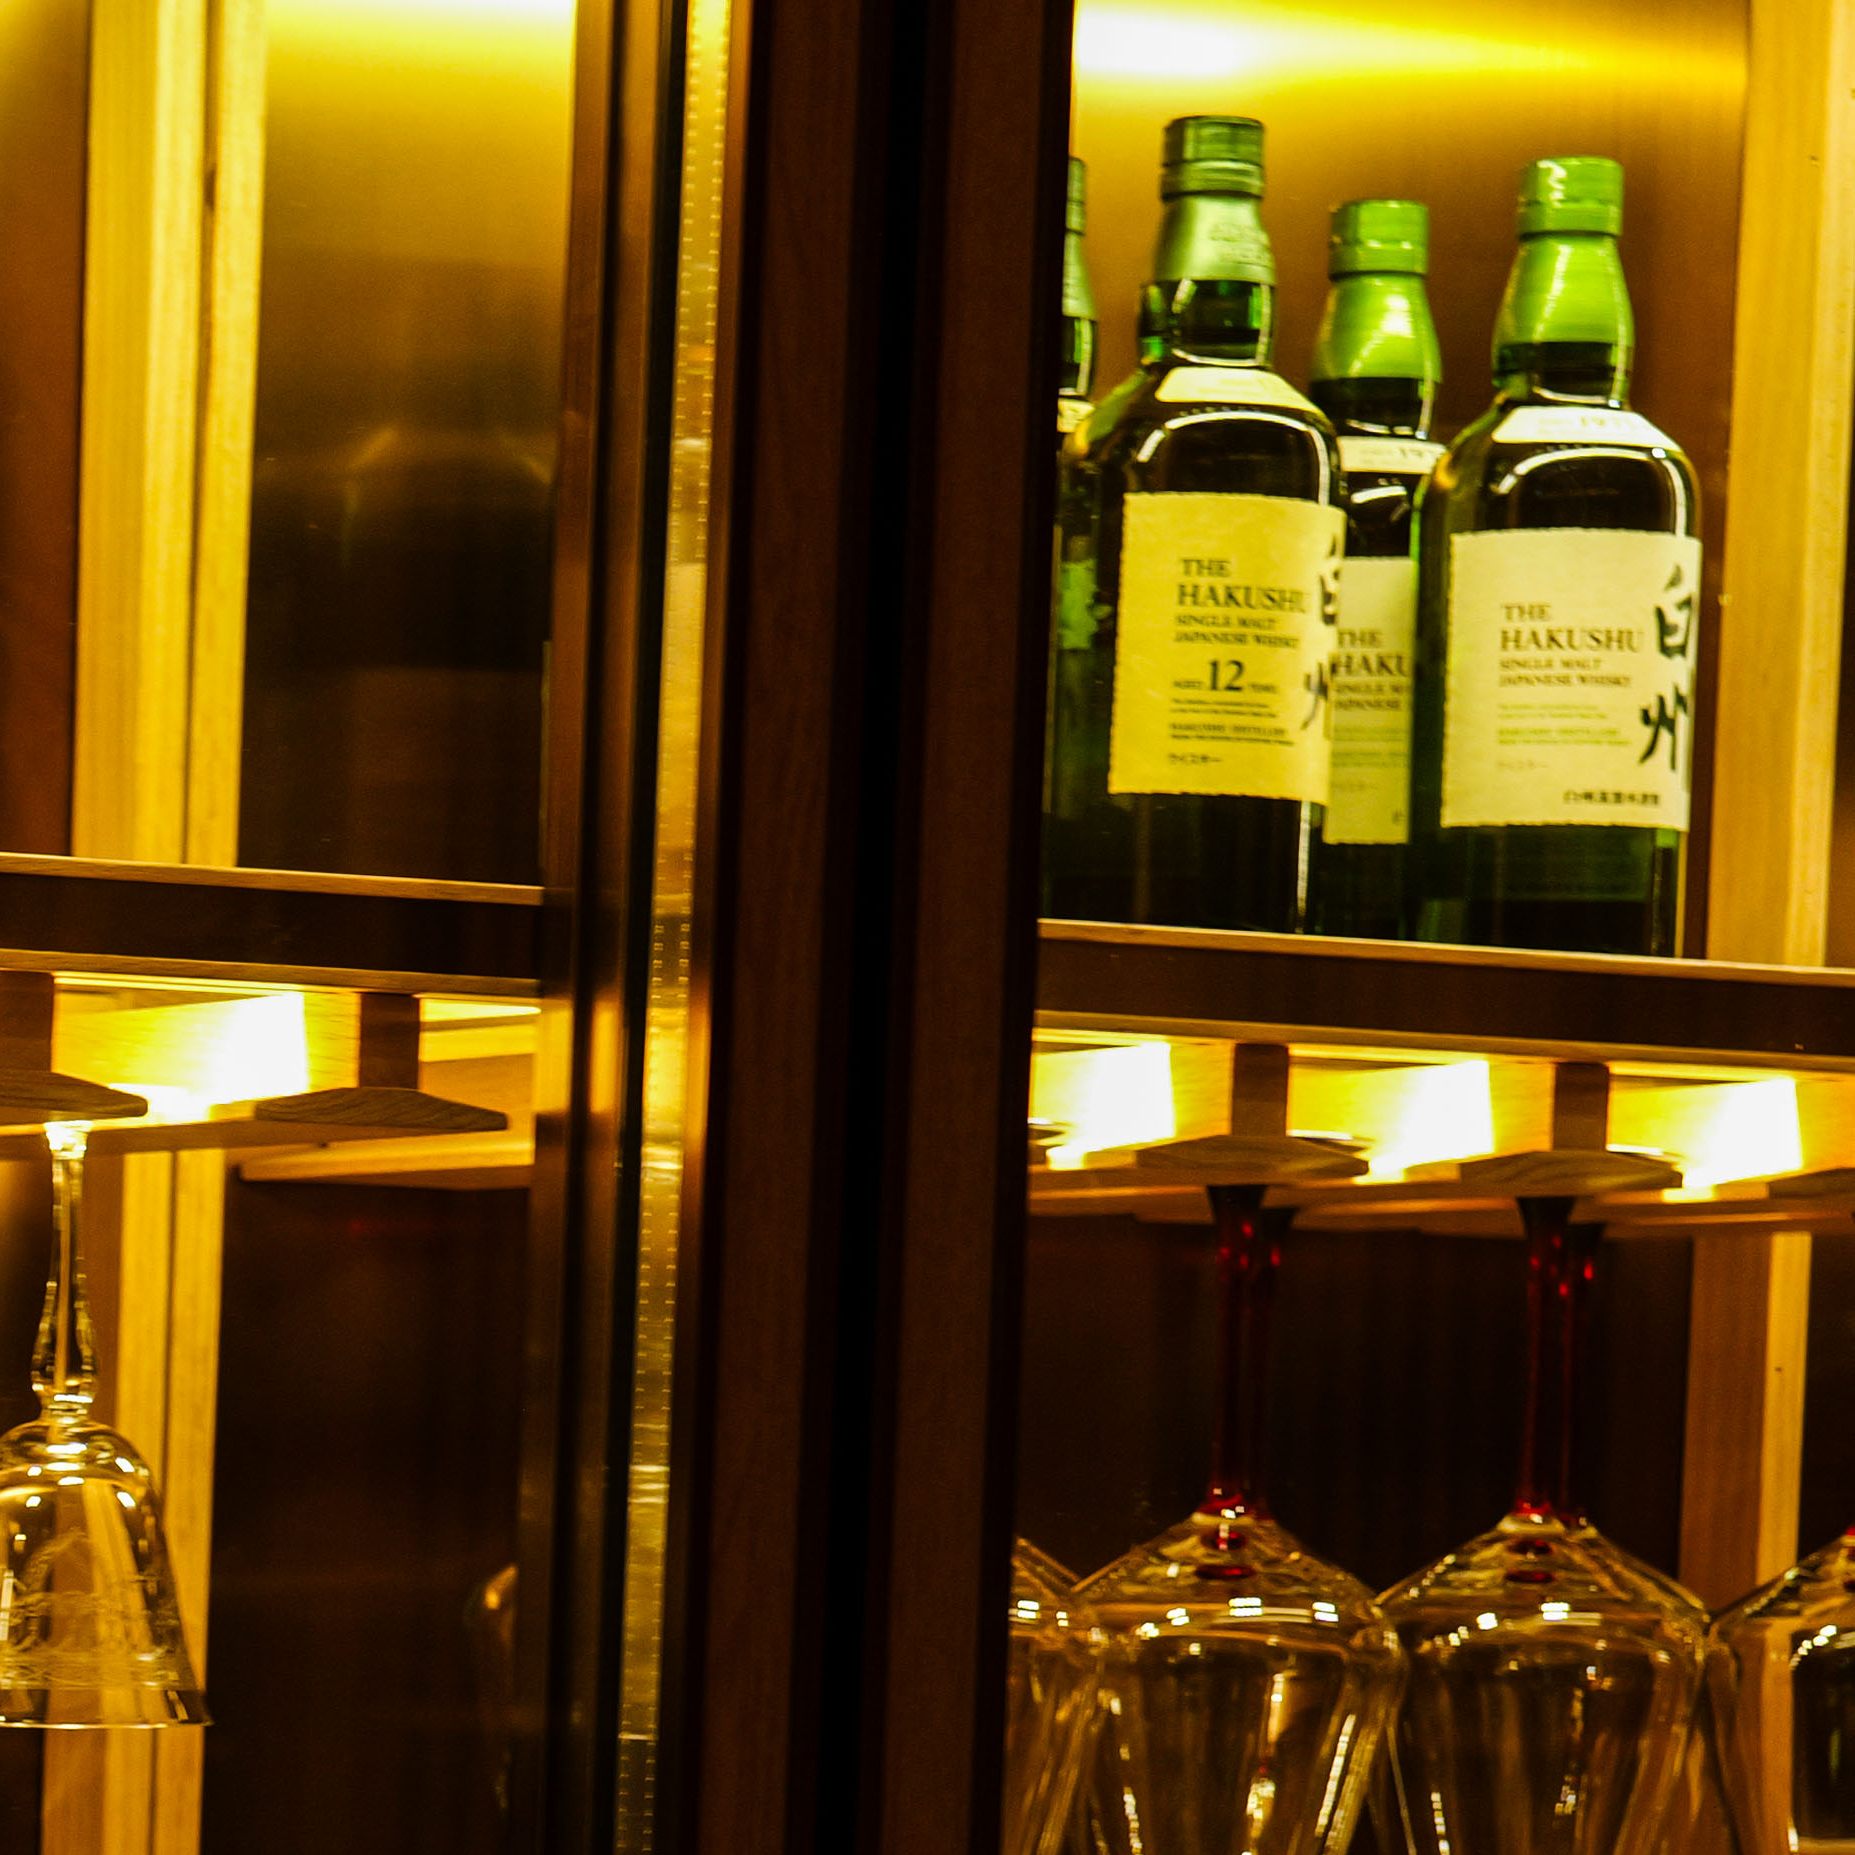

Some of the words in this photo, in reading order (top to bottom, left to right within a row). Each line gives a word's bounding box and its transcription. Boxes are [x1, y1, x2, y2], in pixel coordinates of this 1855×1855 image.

[1180, 558, 1232, 578] THE
[1501, 604, 1551, 623] THE
[1337, 629, 1382, 649] THE
[1500, 629, 1643, 652] HAKUSHU
[1206, 659, 1245, 691] 12
